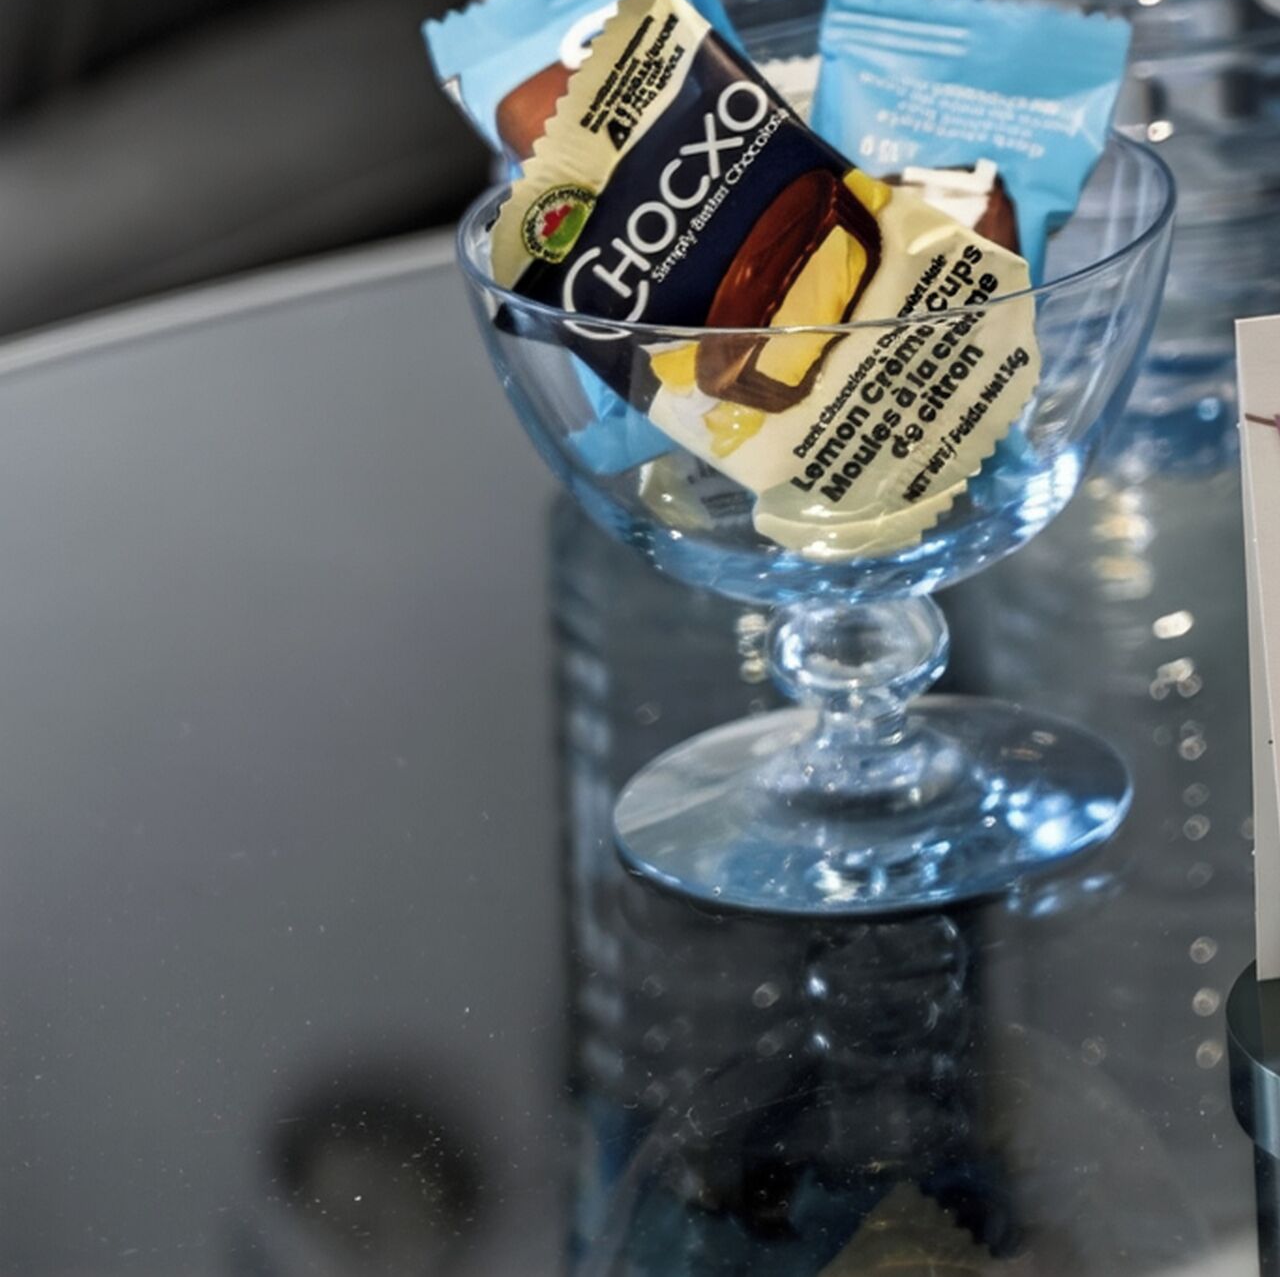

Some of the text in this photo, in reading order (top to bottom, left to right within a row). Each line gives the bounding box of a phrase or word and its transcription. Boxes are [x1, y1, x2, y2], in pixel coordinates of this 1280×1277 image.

[562, 79, 769, 341] CHOCXO
[650, 227, 699, 283] Simply
[790, 404, 872, 492] Lemon
[924, 244, 984, 313] Cups
[820, 408, 903, 504] Moules
[890, 386, 919, 410] à
[905, 360, 938, 387] la
[891, 343, 985, 459] de citron
